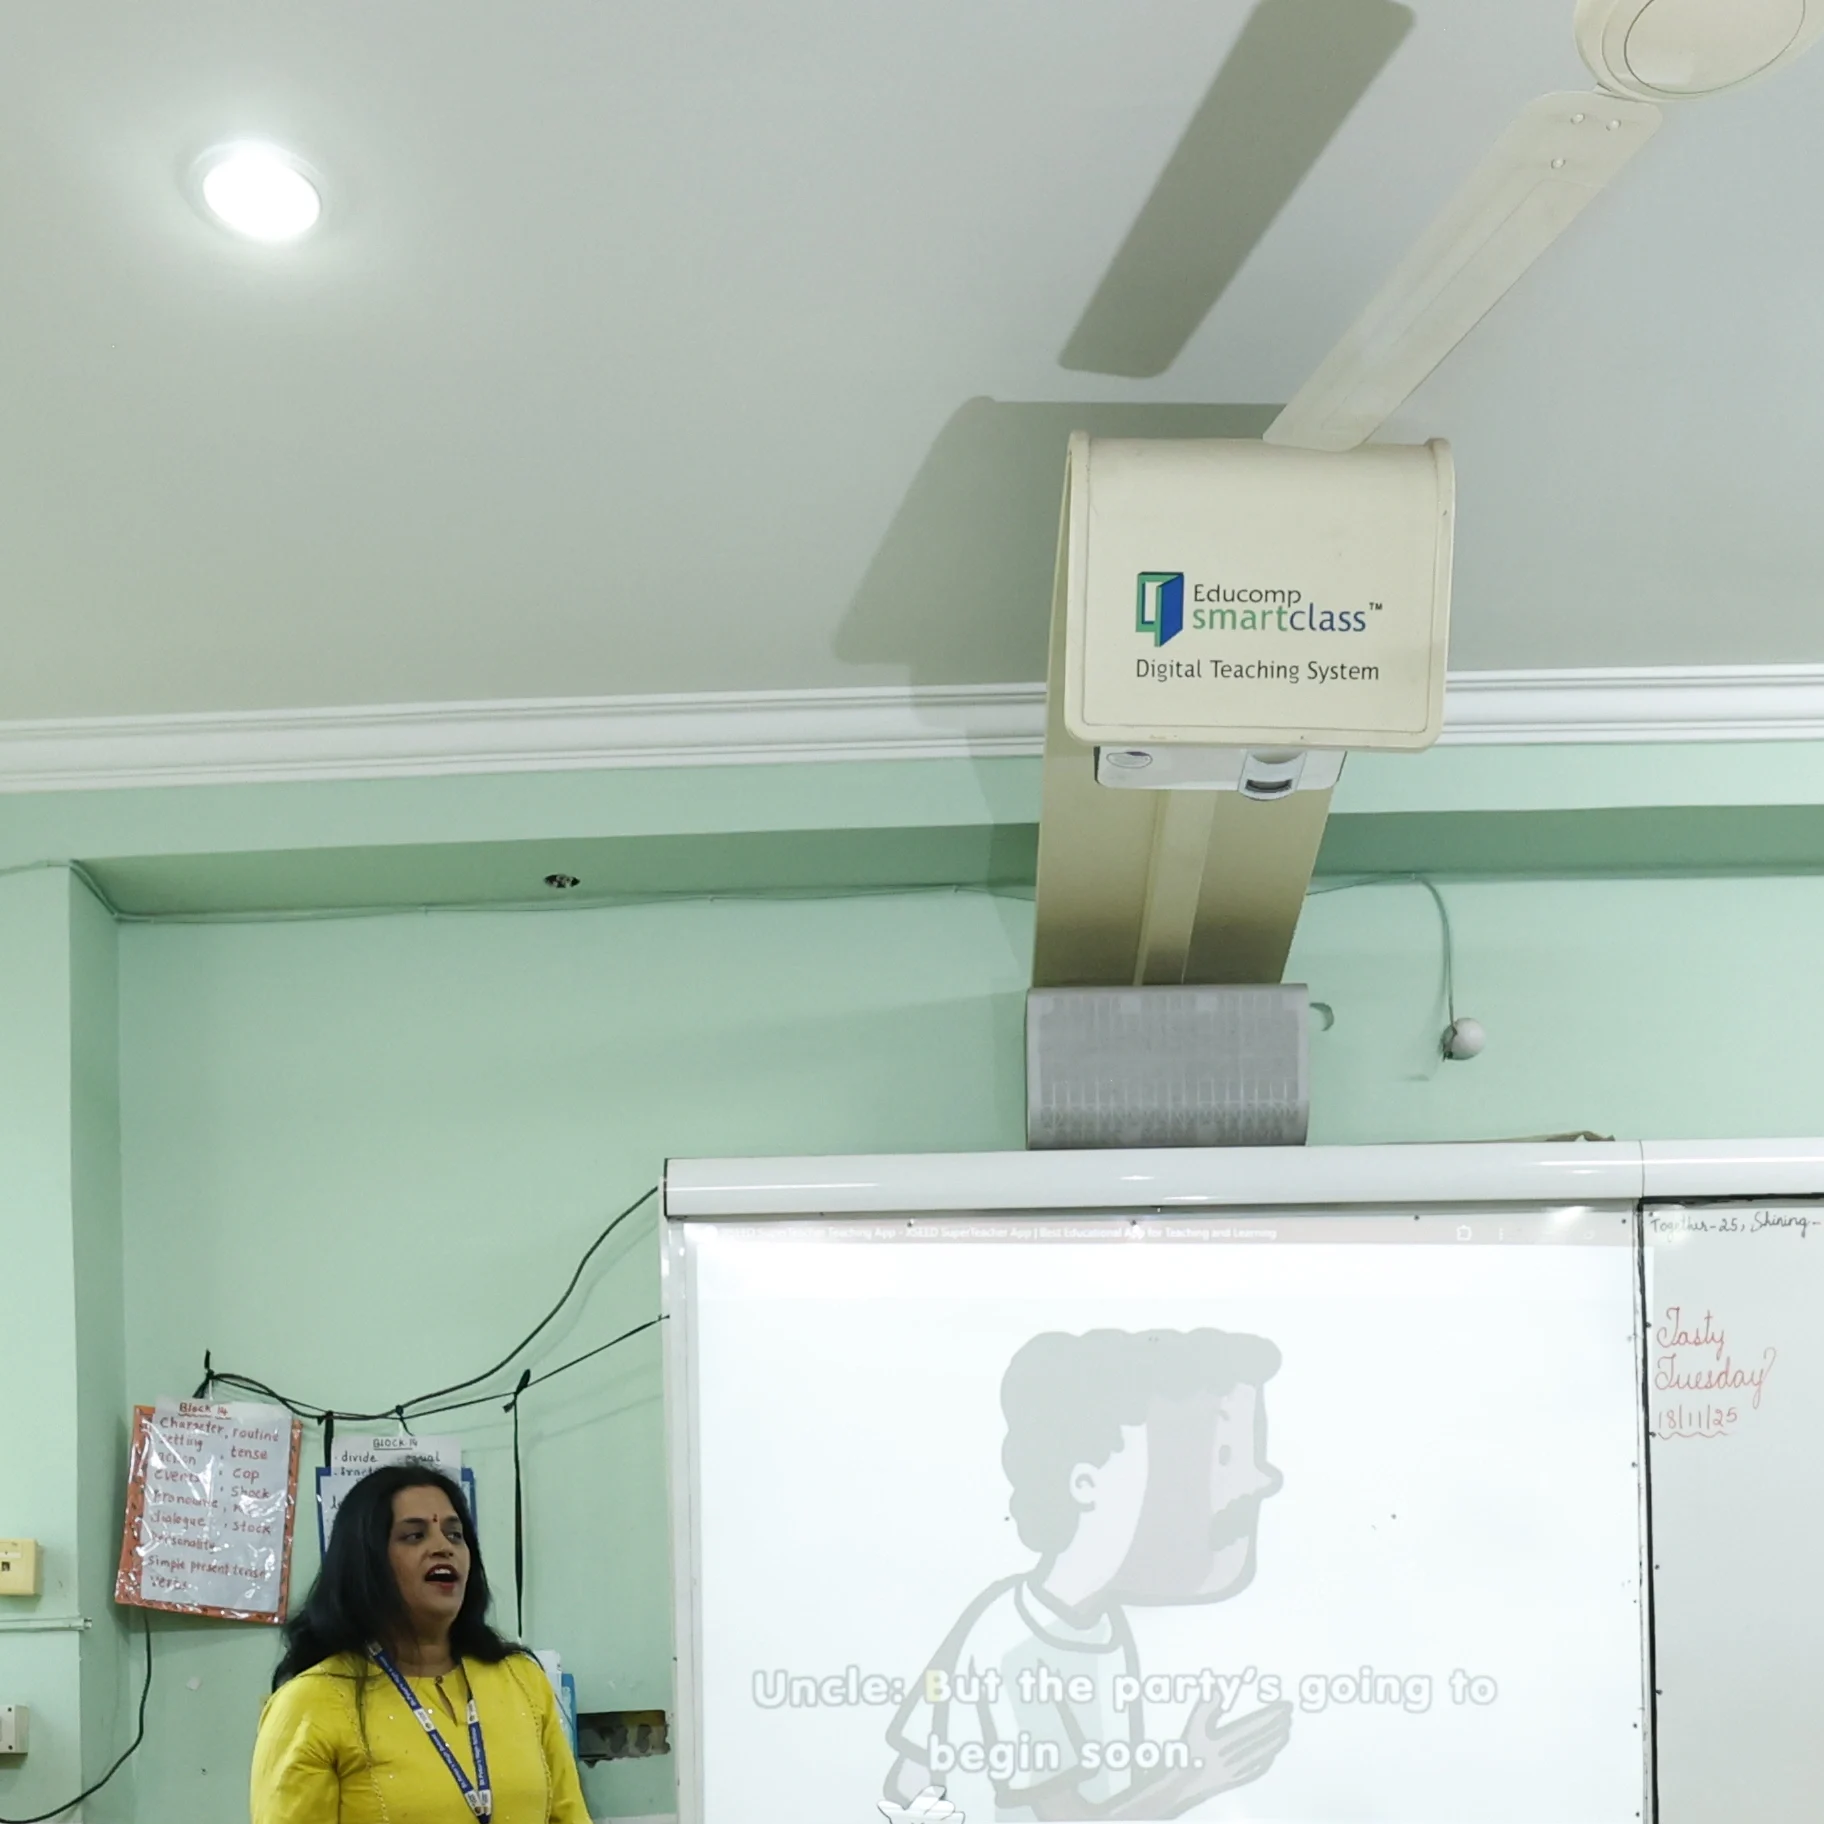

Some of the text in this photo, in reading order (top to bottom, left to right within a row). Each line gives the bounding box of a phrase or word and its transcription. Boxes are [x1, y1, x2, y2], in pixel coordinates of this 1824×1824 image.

[1193, 584, 1302, 605] Educomp
[1192, 602, 1367, 633] smartclass
[1135, 658, 1380, 684] Digital Teaching System
[874, 1227, 896, 1242] App
[1009, 1227, 1033, 1242] App
[1039, 1227, 1063, 1240] Best
[1064, 1227, 1123, 1240] Educational
[1147, 1226, 1163, 1240] for
[1164, 1227, 1209, 1242] Teaching
[1211, 1227, 1232, 1240] and
[1233, 1227, 1278, 1242] Learning
[1656, 1306, 1727, 1361] Tasty
[179, 1402, 212, 1414] Block
[1657, 1402, 1739, 1432] 18/11/25
[230, 1445, 268, 1460] tense
[341, 1451, 379, 1464] divide
[750, 1666, 1498, 1714] Uncle: But the party's going to
[926, 1732, 1205, 1780] begin soon.
